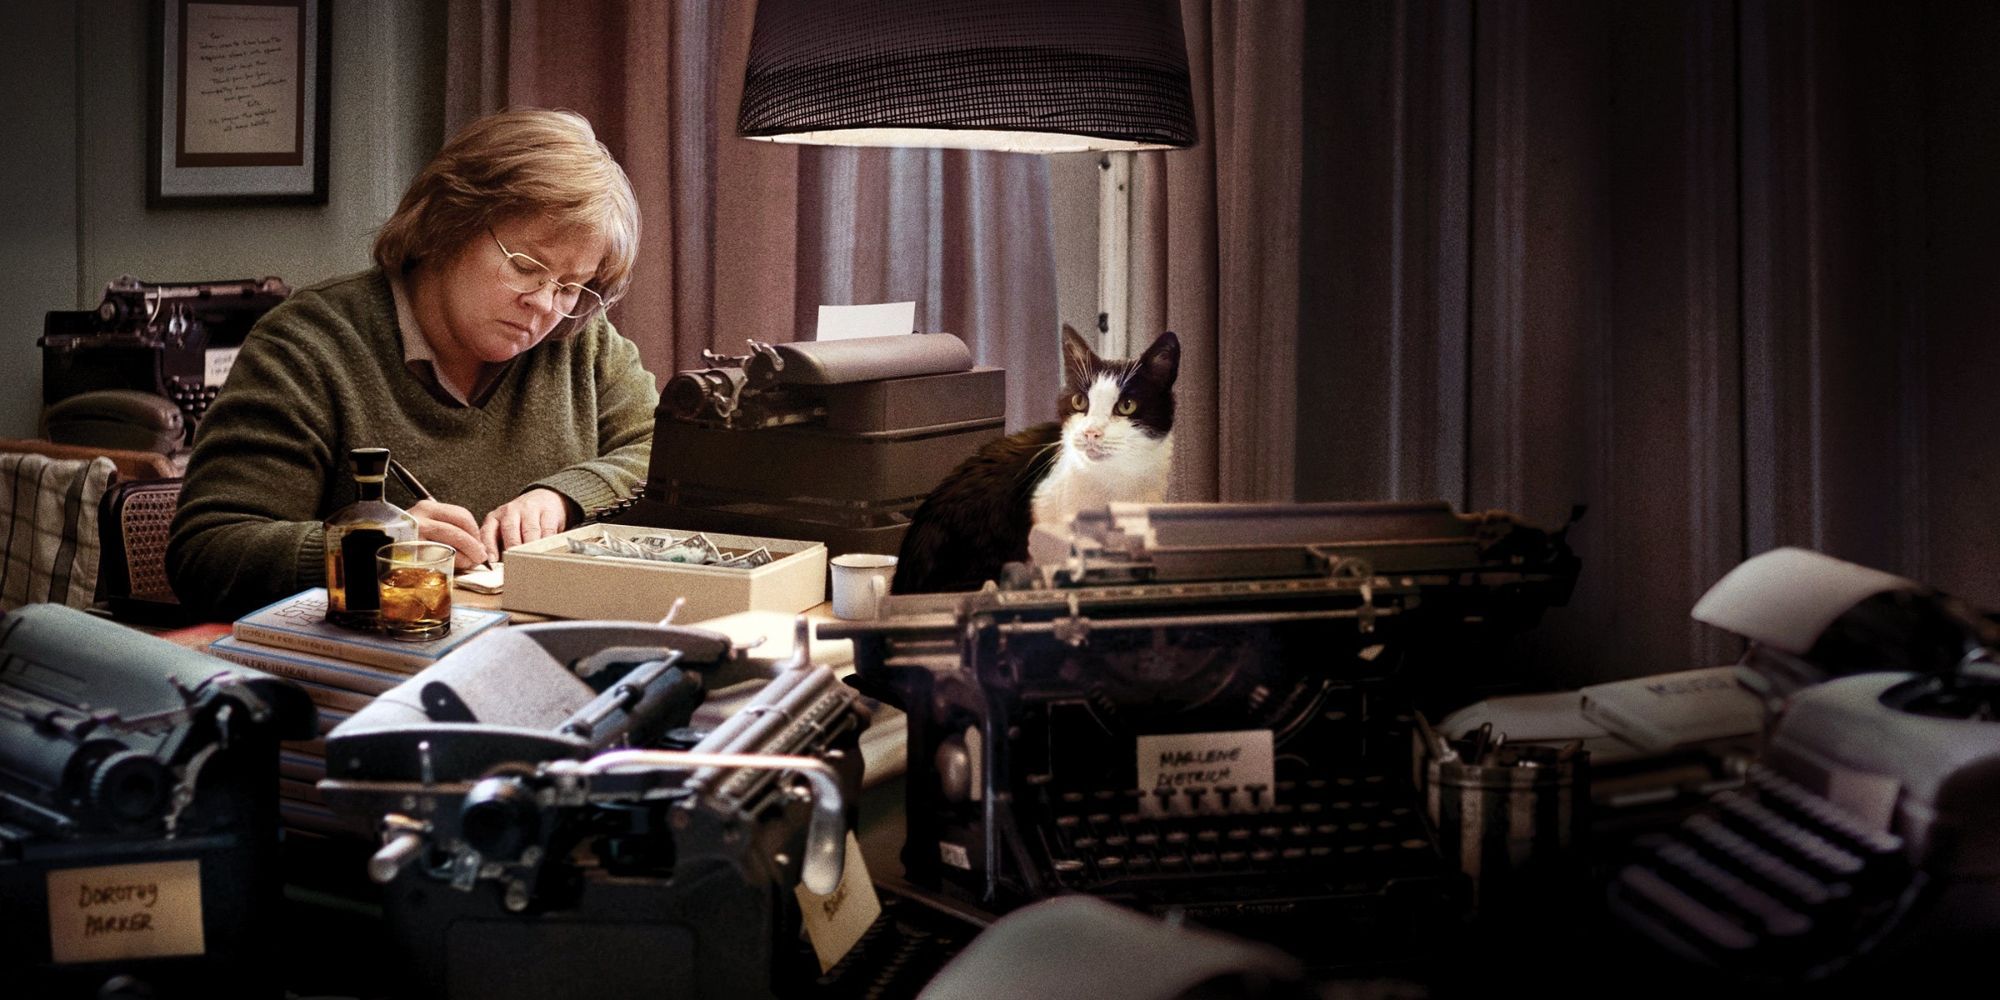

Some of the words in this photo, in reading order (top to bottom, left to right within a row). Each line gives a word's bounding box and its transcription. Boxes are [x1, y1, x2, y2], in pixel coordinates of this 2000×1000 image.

[1161, 748, 1240, 766] MARLENE
[1157, 768, 1230, 785] DIETRICH
[84, 912, 154, 937] PARKER
